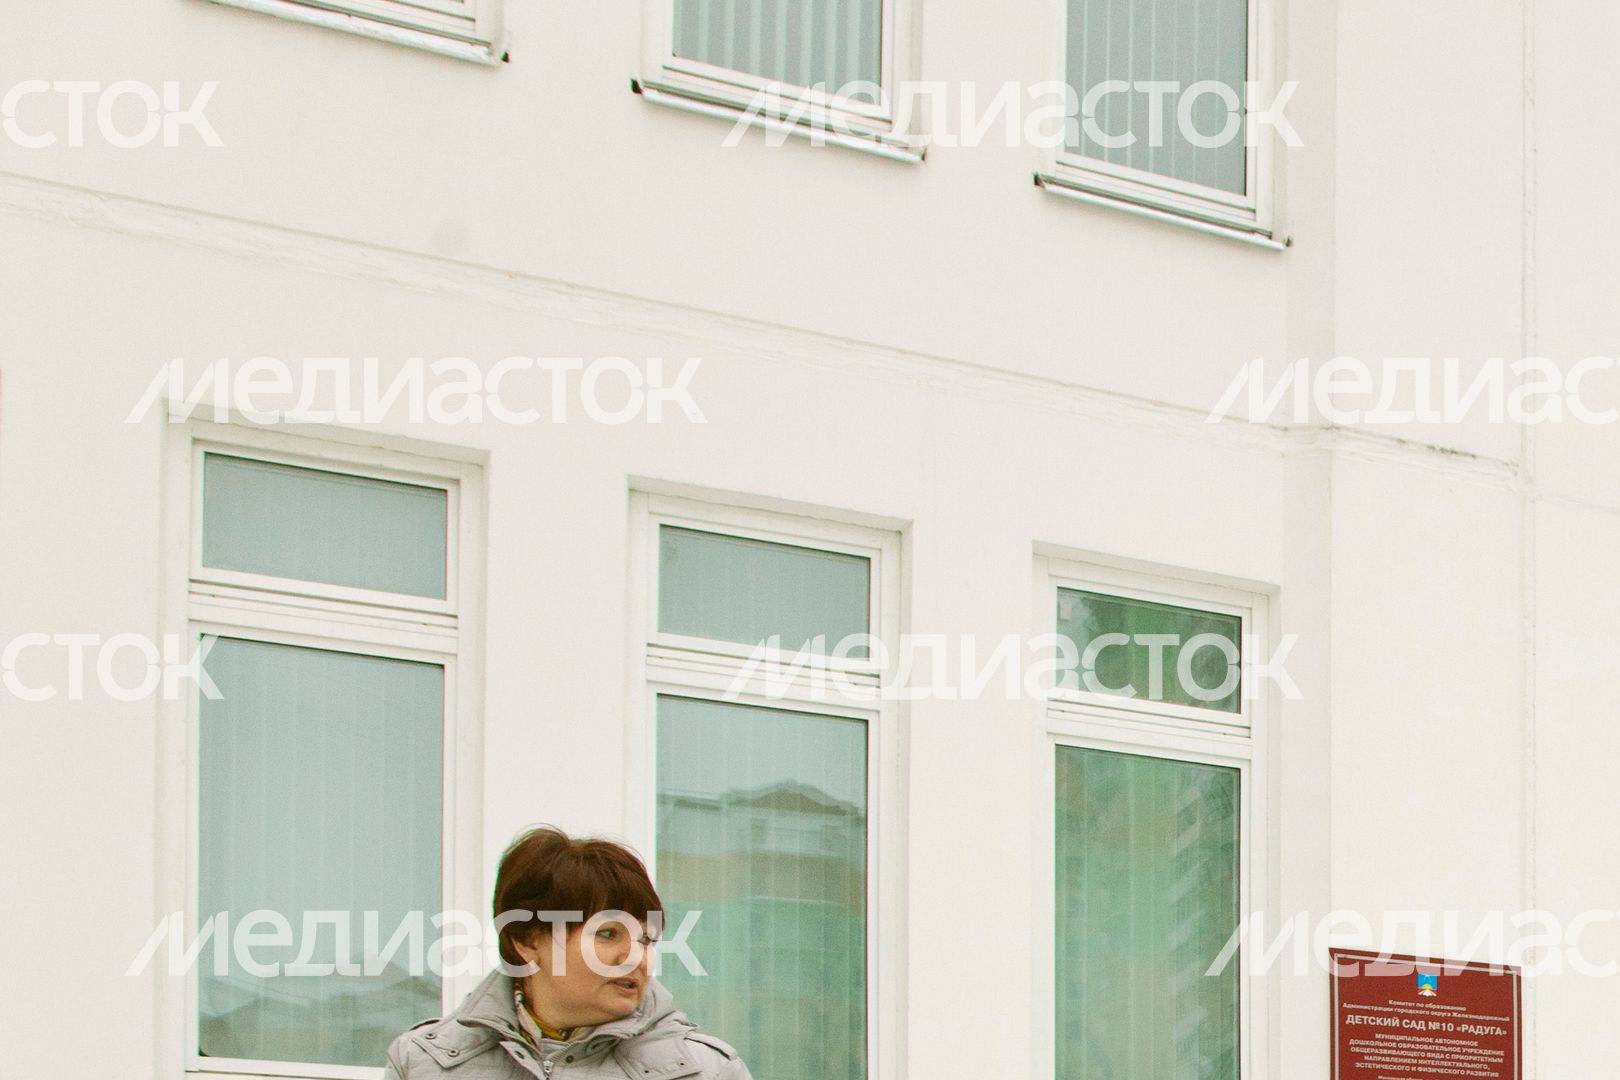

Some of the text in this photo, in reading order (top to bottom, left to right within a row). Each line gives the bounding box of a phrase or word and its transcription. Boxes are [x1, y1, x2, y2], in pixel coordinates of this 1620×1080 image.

[1430, 1009, 1451, 1017] округа
[1346, 1015, 1507, 1036] ДЕТСКИЙ САД №10 «РАДУГА»
[1349, 1039, 1504, 1056] ДОШКОЛЬНОЕ ОБРАЗОВАТЕЛЬНОЕ УЧРЕЖДЕНИЕ
[1375, 1033, 1478, 1047] МУНИЦИПАЛЬНОЕ АВТОНОМНОЕ
[1351, 1047, 1425, 1058] ОБЩЕРАЗВИВАЮЩЕГО
[1427, 1052, 1444, 1060] ВИДА
[1451, 1053, 1503, 1064] ПРИОРИТЕТНЫМ
[1364, 1055, 1417, 1064] НАПРАВЛЕНИЕМ
[1355, 1062, 1410, 1072] ЭСТЕТИЧЕСКОГО
[1417, 1066, 1464, 1076] ФИЗИЧЕСКОГО
[1466, 1069, 1499, 1078] РАЗВИТИЯ
